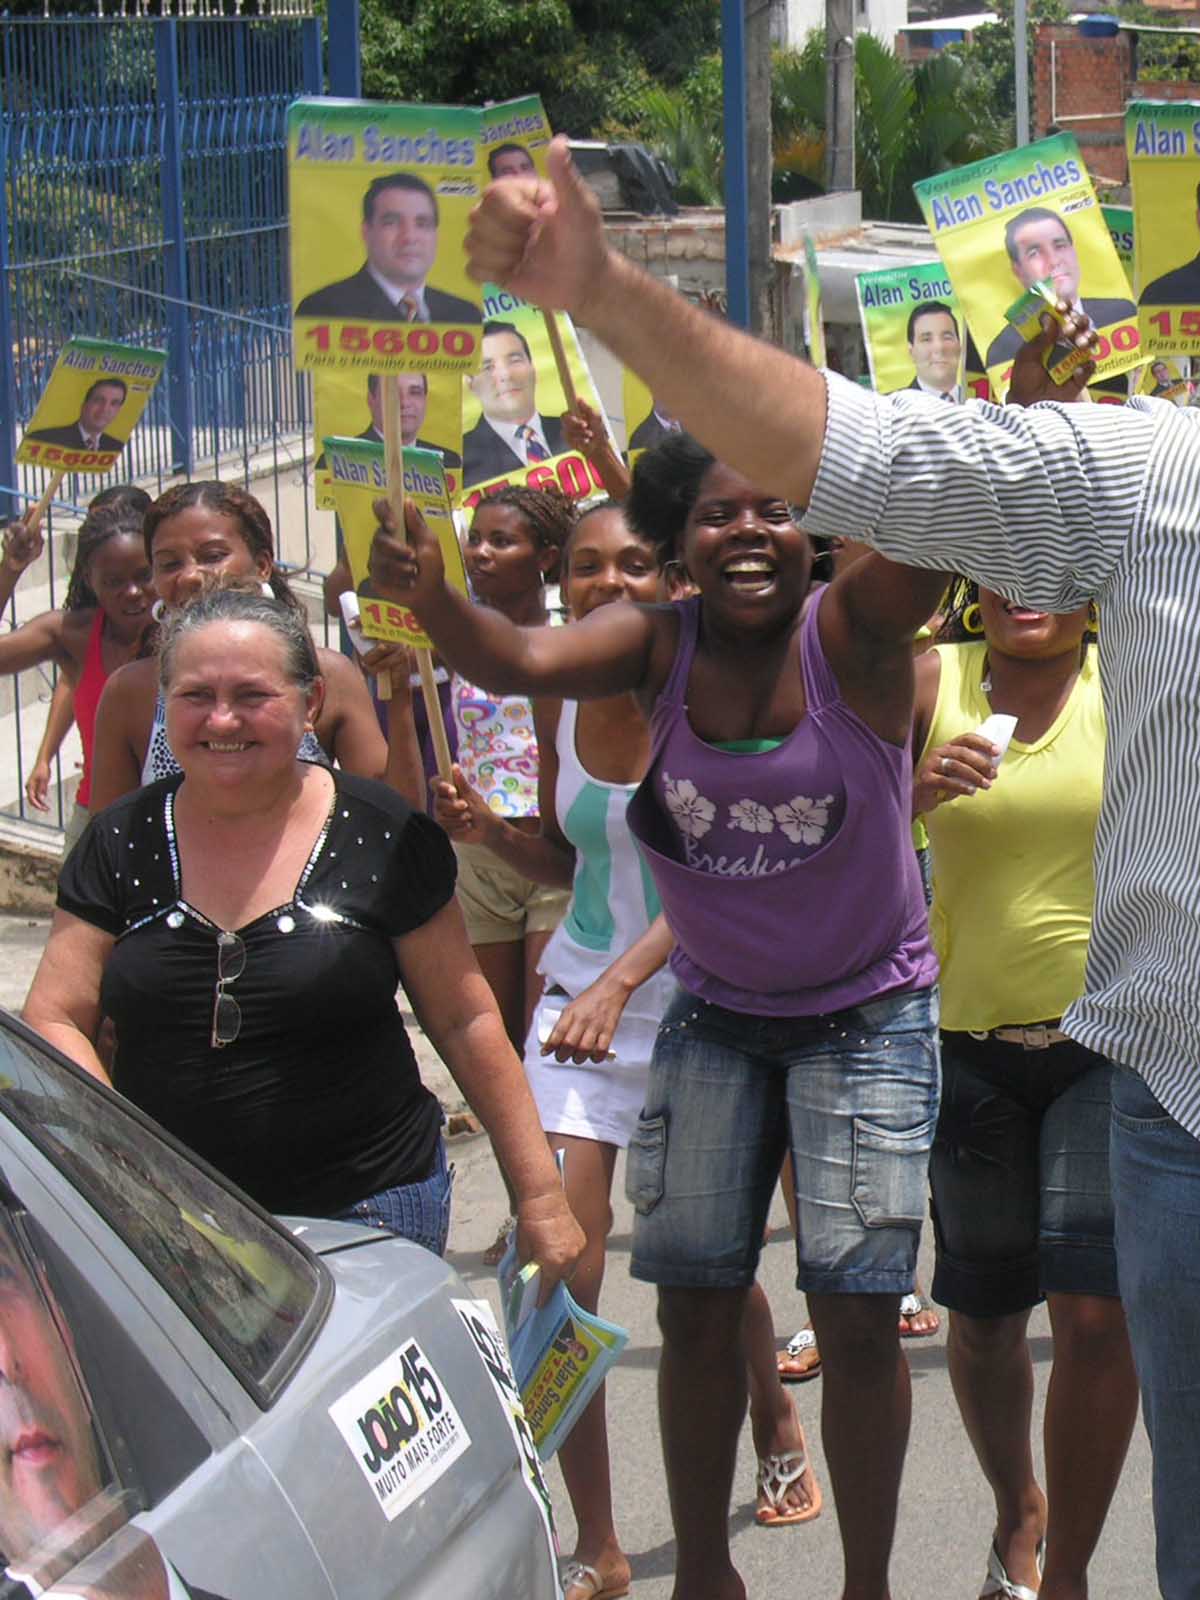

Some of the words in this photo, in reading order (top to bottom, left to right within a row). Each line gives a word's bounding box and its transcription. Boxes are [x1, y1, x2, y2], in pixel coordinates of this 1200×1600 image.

[296, 123, 355, 162] Alan
[363, 124, 475, 167] Sanches
[1134, 119, 1186, 155] Alan
[920, 163, 1000, 196] Vereador
[931, 193, 984, 231] Alan
[984, 160, 1081, 210] Sanches
[864, 283, 904, 307] Alan
[908, 278, 953, 300] Sanc
[304, 325, 475, 357] 15600
[1148, 339, 1177, 350] Para
[63, 350, 97, 371] Alan
[100, 352, 159, 378] Sanches
[304, 353, 335, 367] Para
[26, 444, 118, 467] 15600
[333, 454, 370, 484] Alan
[373, 458, 443, 496] Sches
[365, 603, 423, 634] 156
[529, 1387, 561, 1431] Sanch
[374, 1459, 407, 1498] MUITO
[404, 1438, 430, 1472] MAIS
[426, 1411, 456, 1451] FORTE
